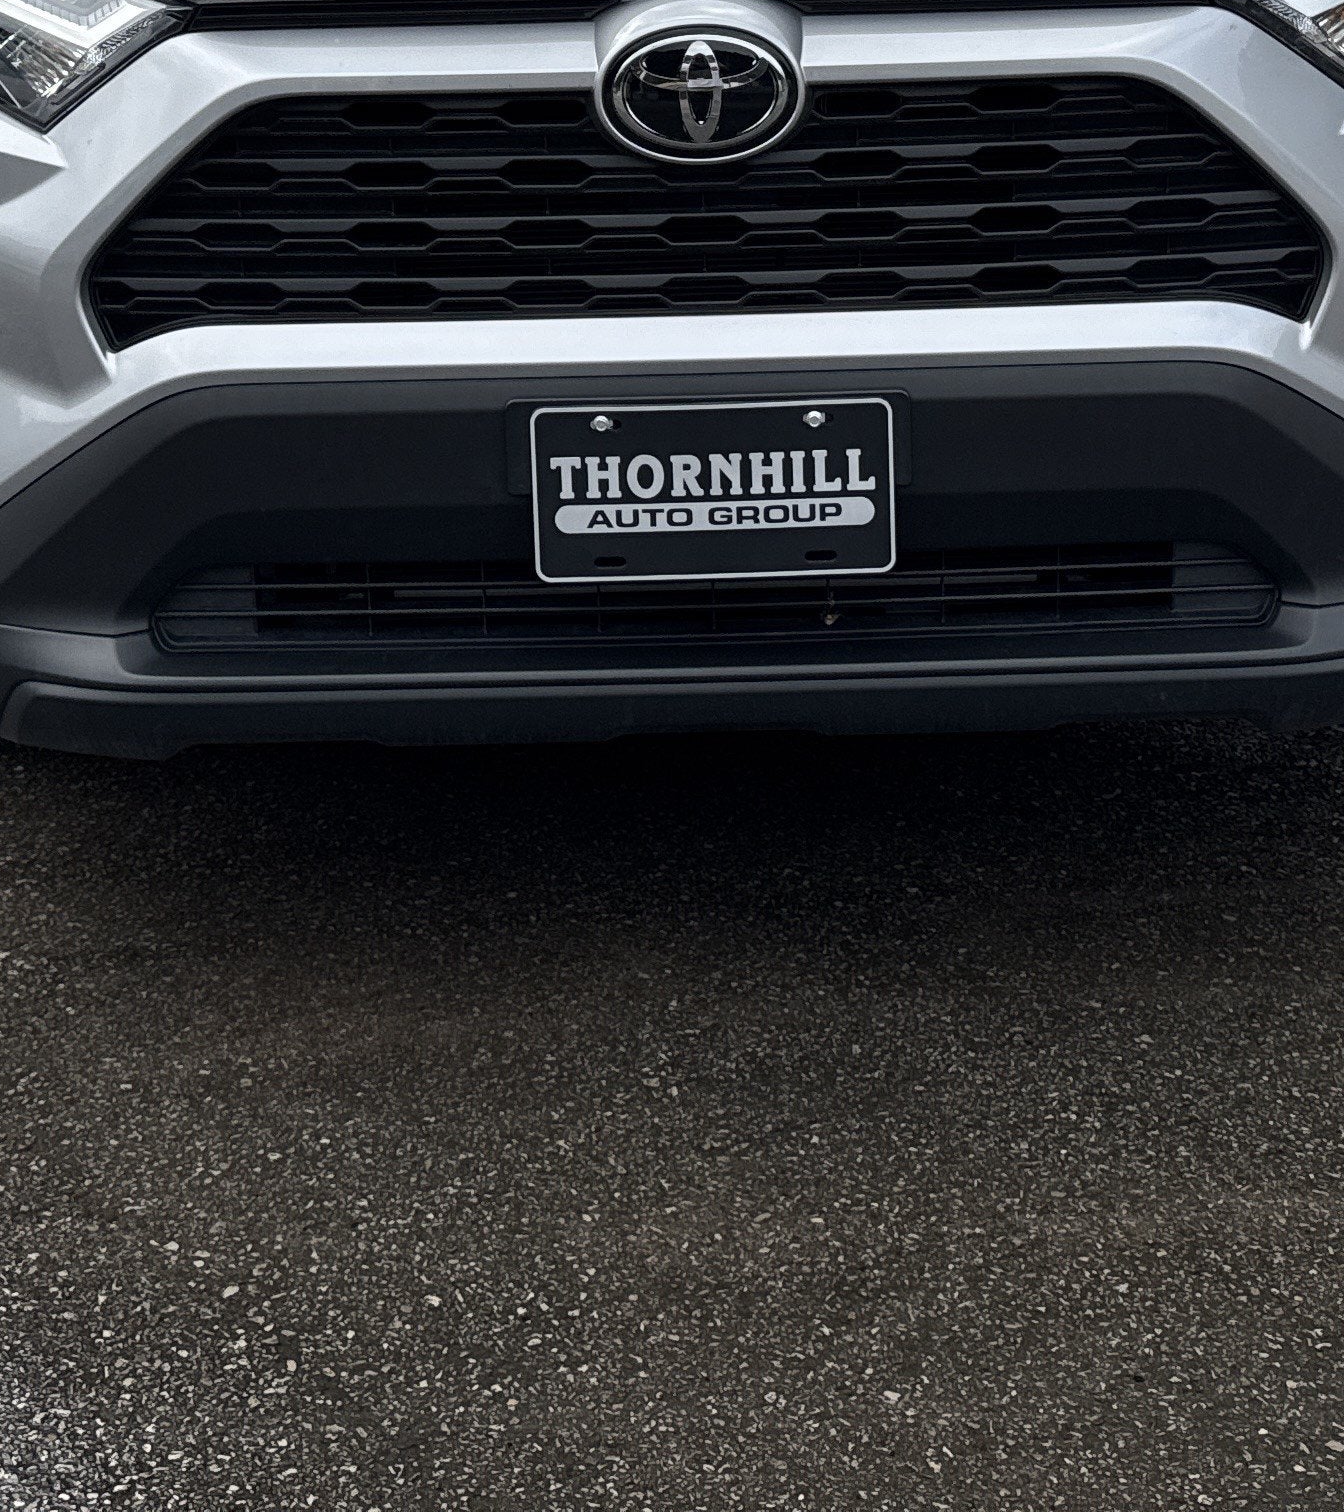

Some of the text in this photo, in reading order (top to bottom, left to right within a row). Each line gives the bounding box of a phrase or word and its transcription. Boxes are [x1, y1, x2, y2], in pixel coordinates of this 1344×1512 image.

[549, 448, 876, 500] THORNHILL
[587, 502, 843, 529] AUTO GROUP
